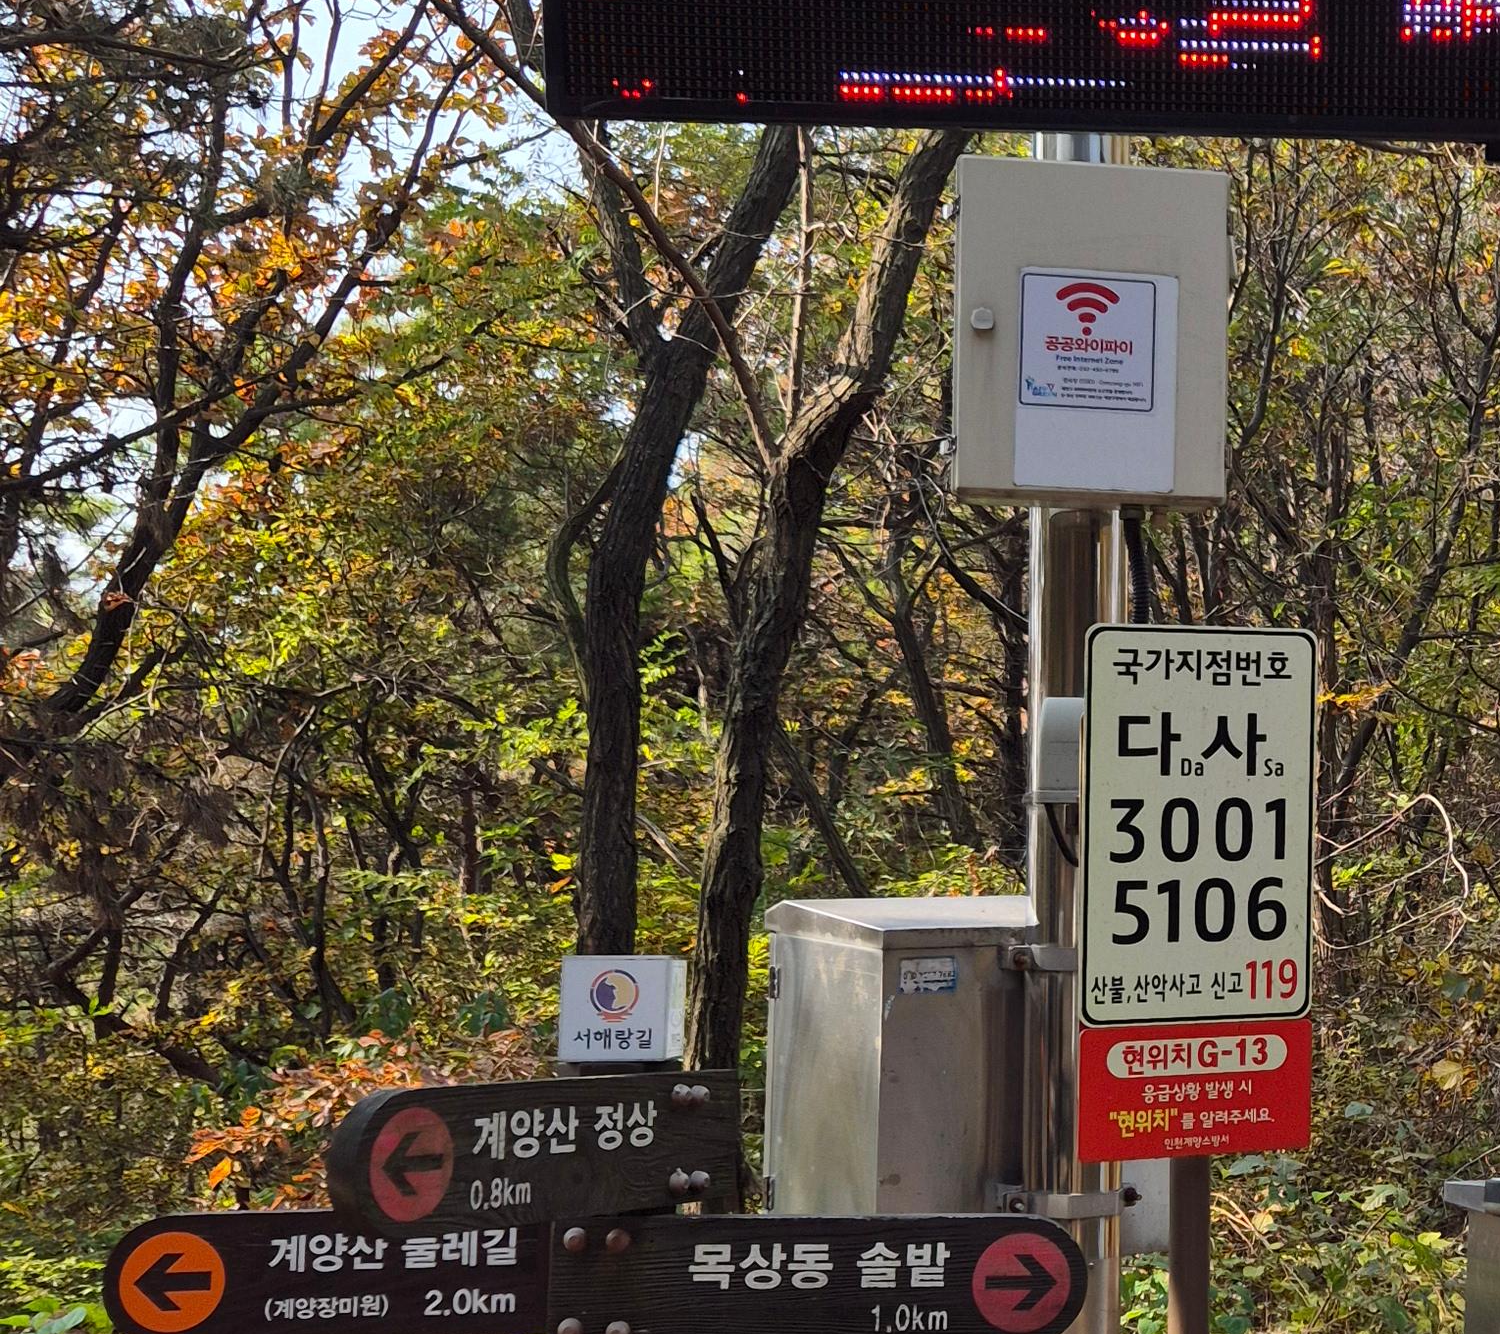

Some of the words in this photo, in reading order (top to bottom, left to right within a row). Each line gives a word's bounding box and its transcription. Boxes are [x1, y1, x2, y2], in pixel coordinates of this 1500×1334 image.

[1045, 336, 1133, 355] 공공와이파이
[1056, 354, 1072, 362] Free
[1073, 355, 1102, 364] Internet
[1105, 357, 1123, 365] Zone
[1113, 648, 1292, 687] 국가지점번호
[1109, 797, 1286, 863] 3001
[1112, 877, 1287, 946] 5106
[1090, 973, 1202, 1005] 산불,산악사고
[1211, 972, 1243, 1000] 신고
[1245, 958, 1298, 1000] 119
[573, 1028, 652, 1050] 서해랑길
[1122, 1043, 1191, 1076] 현위치
[1198, 1037, 1268, 1068] G-13
[1142, 1082, 1200, 1104] 응급상황
[1205, 1080, 1234, 1099] 발생
[1239, 1079, 1252, 1095] 시
[472, 1106, 579, 1160] 계양산
[594, 1100, 657, 1151] 정상
[1200, 1108, 1275, 1129] 알려주세요.
[1164, 1136, 1229, 1150] 인천계양소방서
[470, 1177, 531, 1211] 0.8km
[268, 1232, 388, 1273] 계양산
[401, 1227, 518, 1269] 둘레길
[688, 1242, 833, 1290] 목상동
[856, 1242, 950, 1288] 솔밭
[264, 1294, 389, 1321] (계양장미원)
[423, 1289, 516, 1317] 2.0km
[871, 1304, 948, 1333] 1.0km
